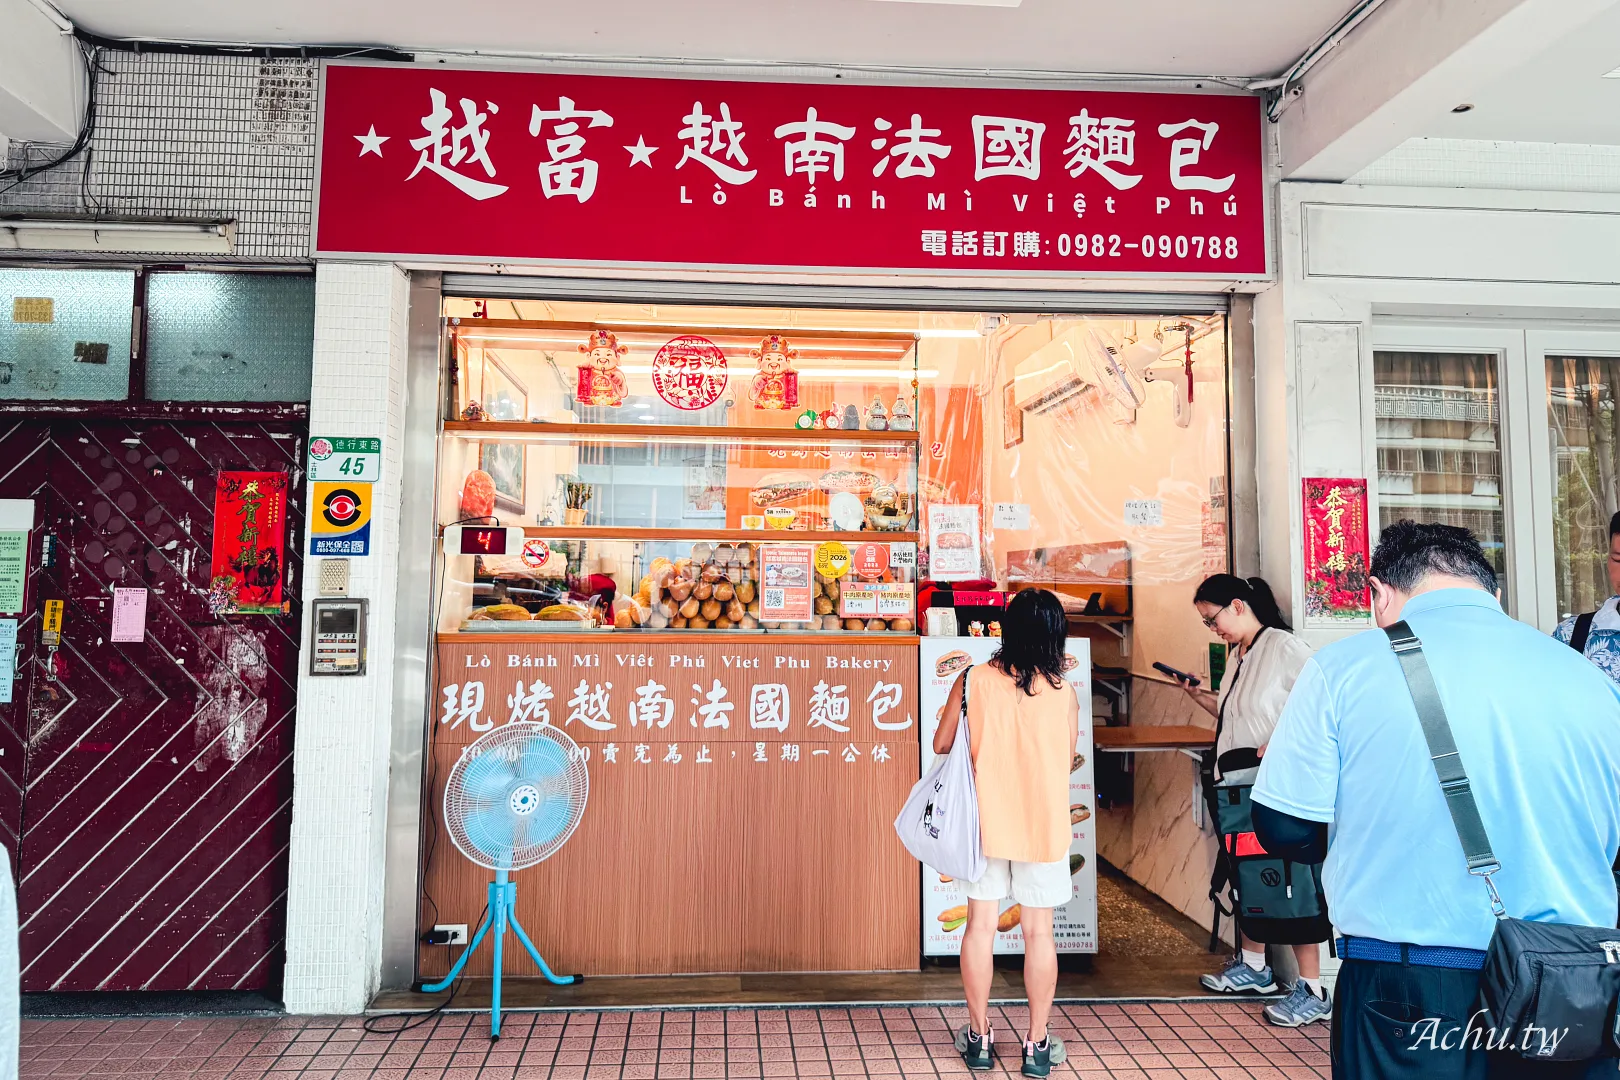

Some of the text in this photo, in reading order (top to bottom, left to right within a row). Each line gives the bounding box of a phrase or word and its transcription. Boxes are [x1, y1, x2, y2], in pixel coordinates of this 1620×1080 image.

[404, 88, 1236, 203] 越富 越南法國麵包
[680, 183, 1238, 220] Lò Bánh Mì Việt Phú
[669, 355, 705, 390] 福
[335, 439, 380, 451] 德行東路
[338, 457, 367, 476] 45
[236, 480, 265, 566] 恭賀新禧
[1322, 485, 1350, 572] 恭賀新禧
[316, 540, 351, 549] 新光保全
[477, 530, 492, 552] 4
[465, 654, 491, 667] Lò
[507, 654, 558, 667] Bánh
[573, 654, 599, 667] Mì
[669, 654, 705, 668] Phú
[721, 655, 760, 668] Viet
[774, 655, 811, 668] Phu
[825, 655, 893, 672] Bakery
[441, 678, 913, 732] 現烤越南法國麵包
